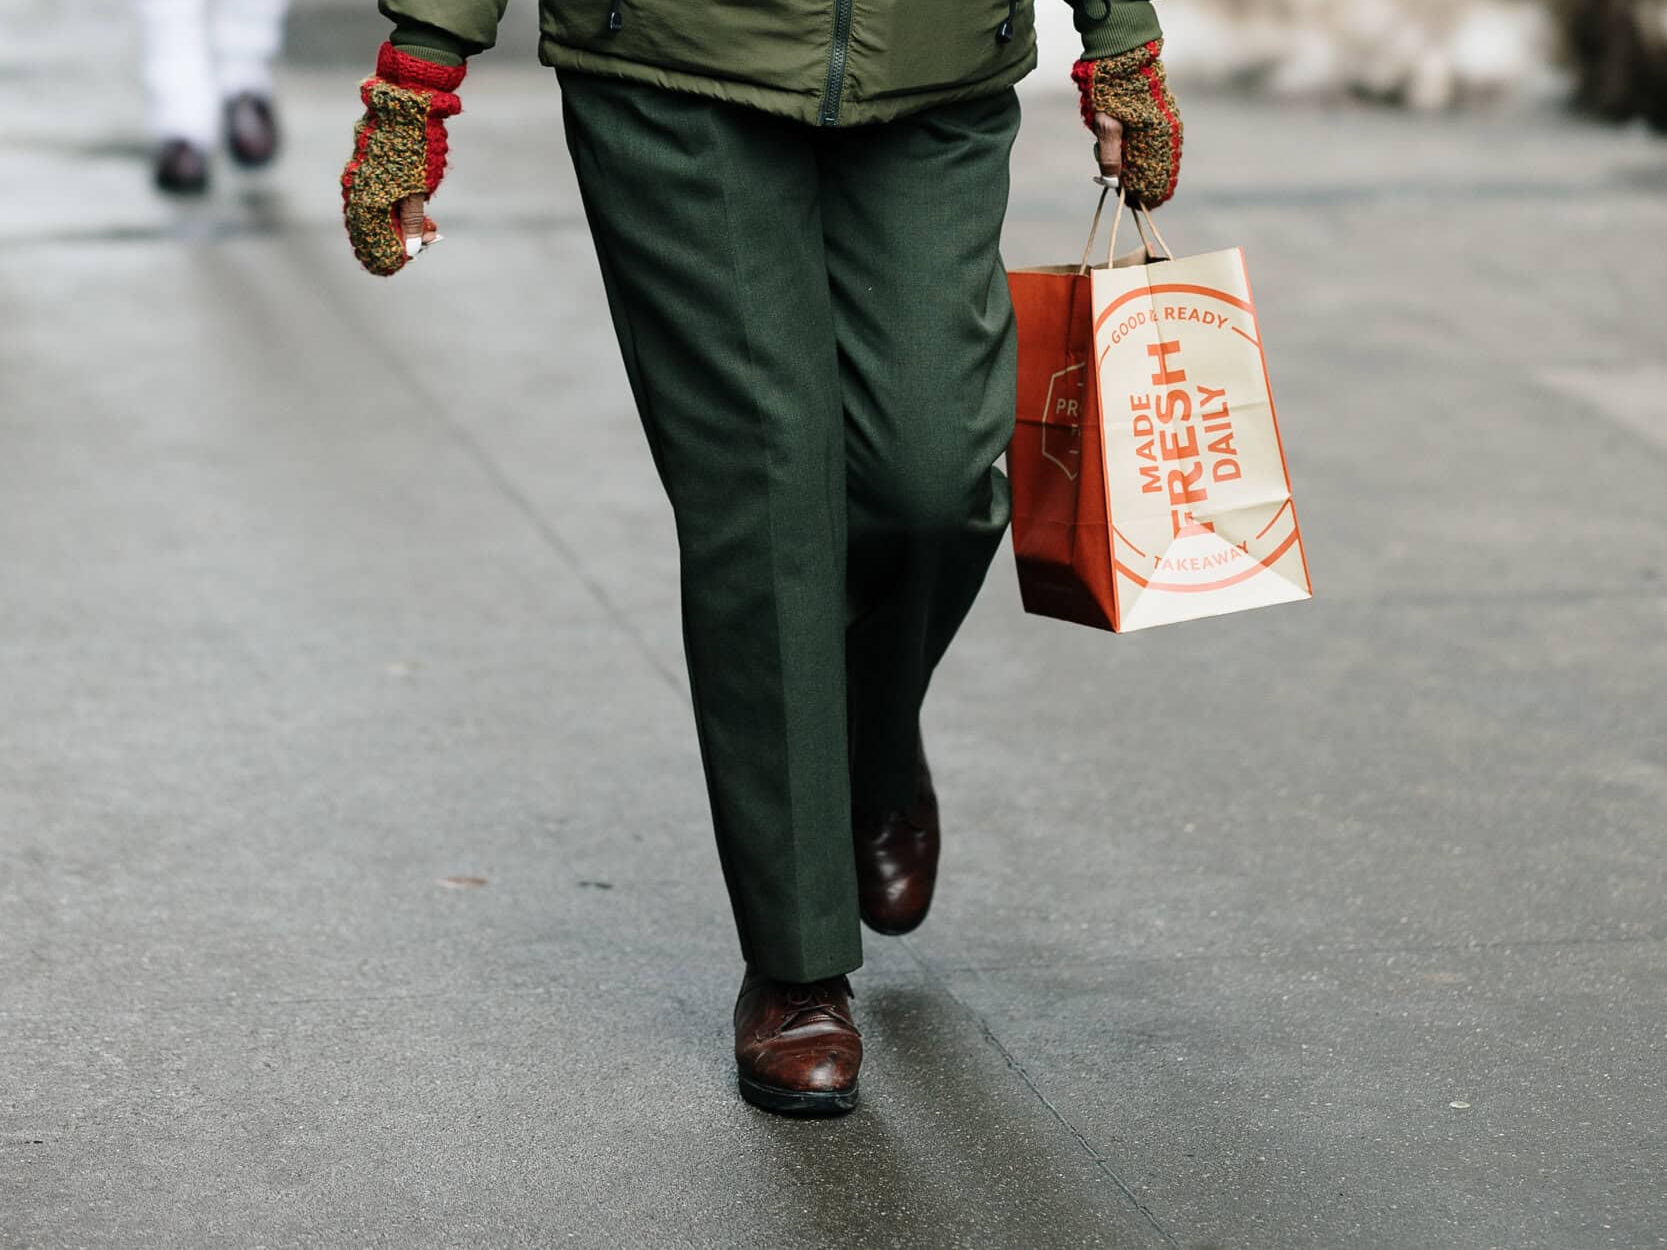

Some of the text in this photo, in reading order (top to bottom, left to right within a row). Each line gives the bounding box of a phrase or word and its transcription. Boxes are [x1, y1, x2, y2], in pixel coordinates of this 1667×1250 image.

[1111, 312, 1145, 344] GOOD
[1164, 307, 1228, 328] READY
[1130, 393, 1162, 494] MADE
[1146, 340, 1215, 540] FRESH
[1197, 385, 1242, 483] DAILY
[1154, 540, 1249, 571] TAKEAWAY
